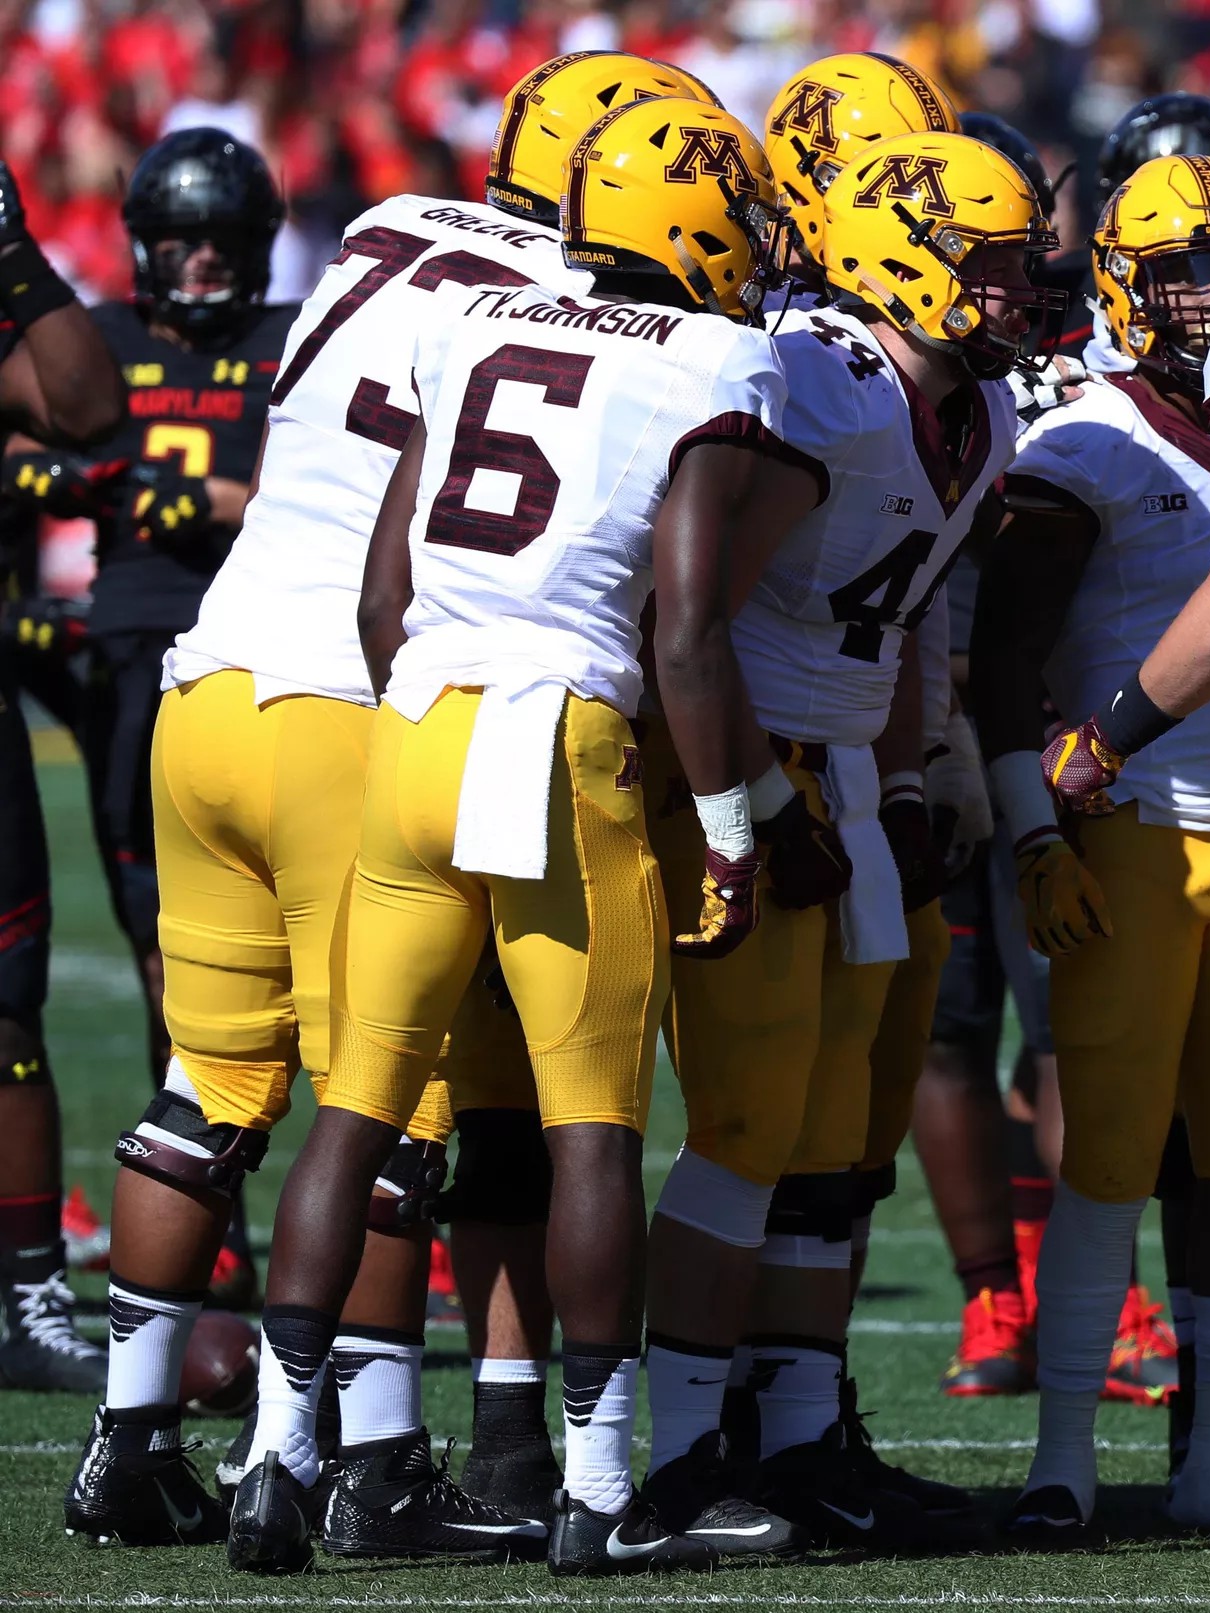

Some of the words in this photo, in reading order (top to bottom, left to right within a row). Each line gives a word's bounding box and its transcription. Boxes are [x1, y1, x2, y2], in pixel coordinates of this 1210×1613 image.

[769, 80, 845, 154] M
[664, 127, 759, 195] M
[853, 154, 956, 219] M
[420, 207, 559, 249] GREENE
[128, 387, 245, 421] MARYLAND
[424, 342, 596, 557] 6
